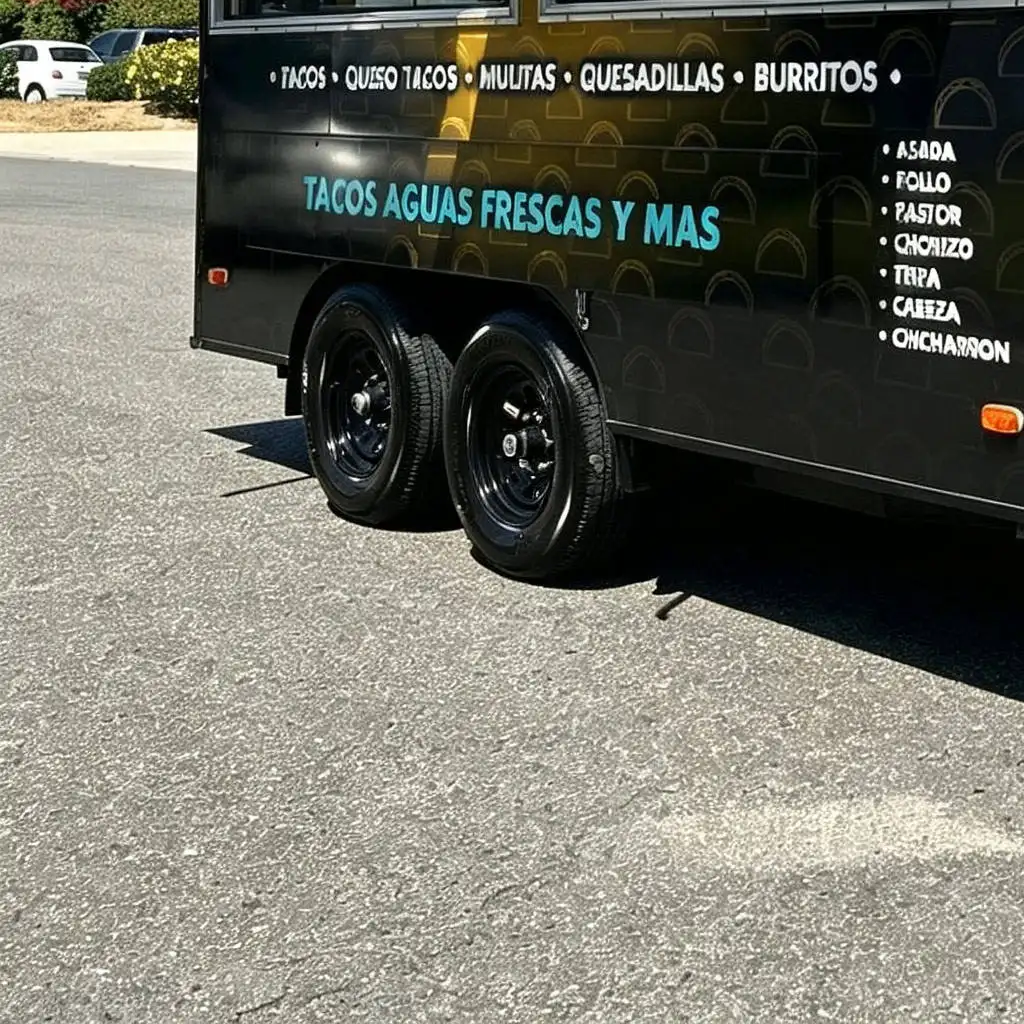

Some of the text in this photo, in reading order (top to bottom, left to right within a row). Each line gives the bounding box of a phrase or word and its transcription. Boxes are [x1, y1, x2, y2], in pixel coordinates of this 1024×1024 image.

[281, 66, 326, 89] TACOS
[402, 64, 457, 91] TACOS
[479, 63, 557, 92] MULITAS
[580, 62, 724, 93] QUESADILLAS
[755, 61, 878, 93] BURRITOS
[896, 140, 957, 162] ASADA
[304, 176, 721, 251] TACOS AGUAS FRESCAS Y MAS
[895, 201, 962, 227] PASTOR
